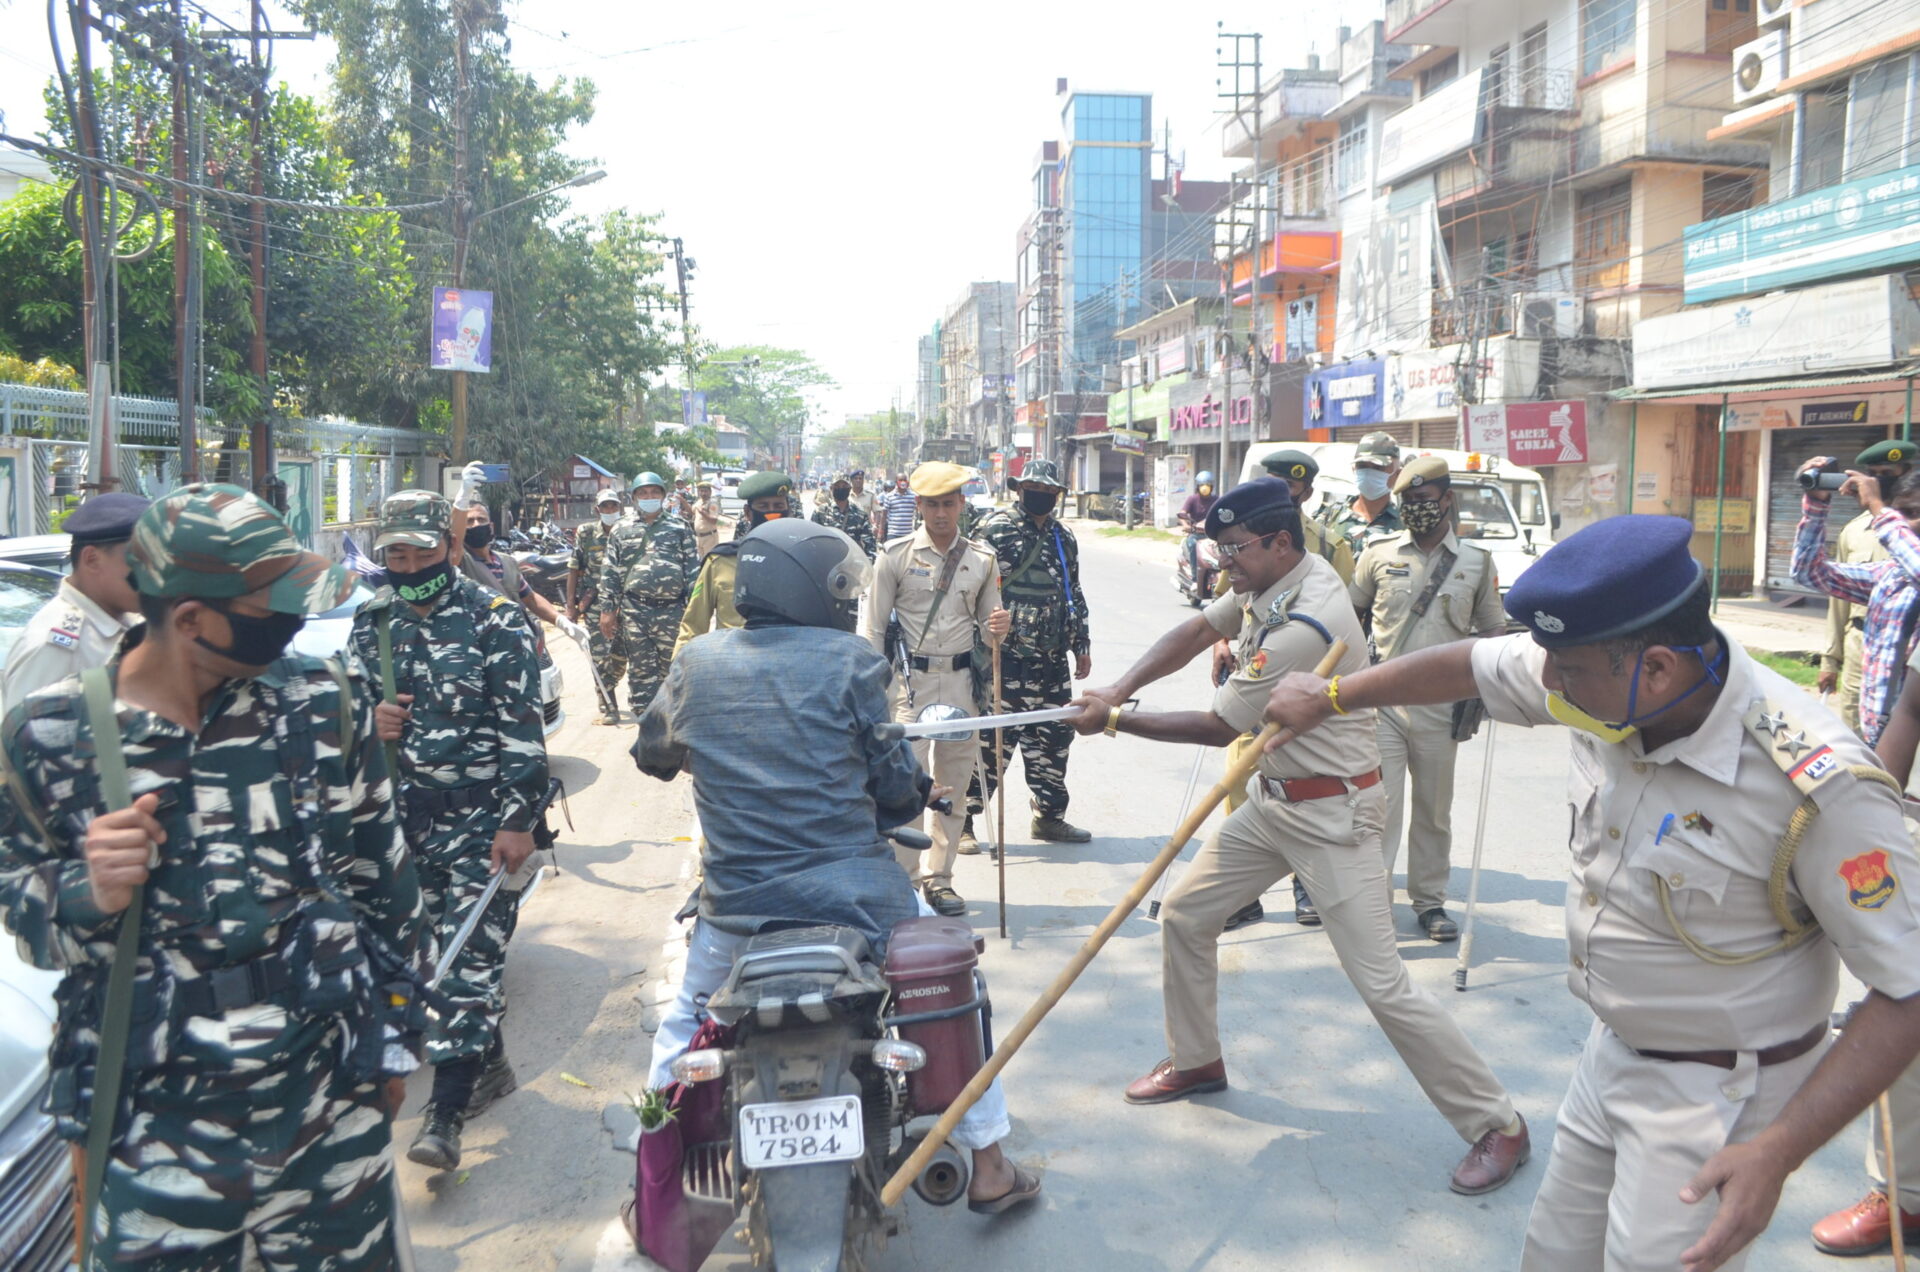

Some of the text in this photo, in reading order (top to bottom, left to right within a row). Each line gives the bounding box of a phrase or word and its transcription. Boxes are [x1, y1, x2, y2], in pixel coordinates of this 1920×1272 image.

[1510, 427, 1549, 440] SAREE
[1515, 439, 1556, 451] KUNJA
[759, 1134, 841, 1161] 7584
